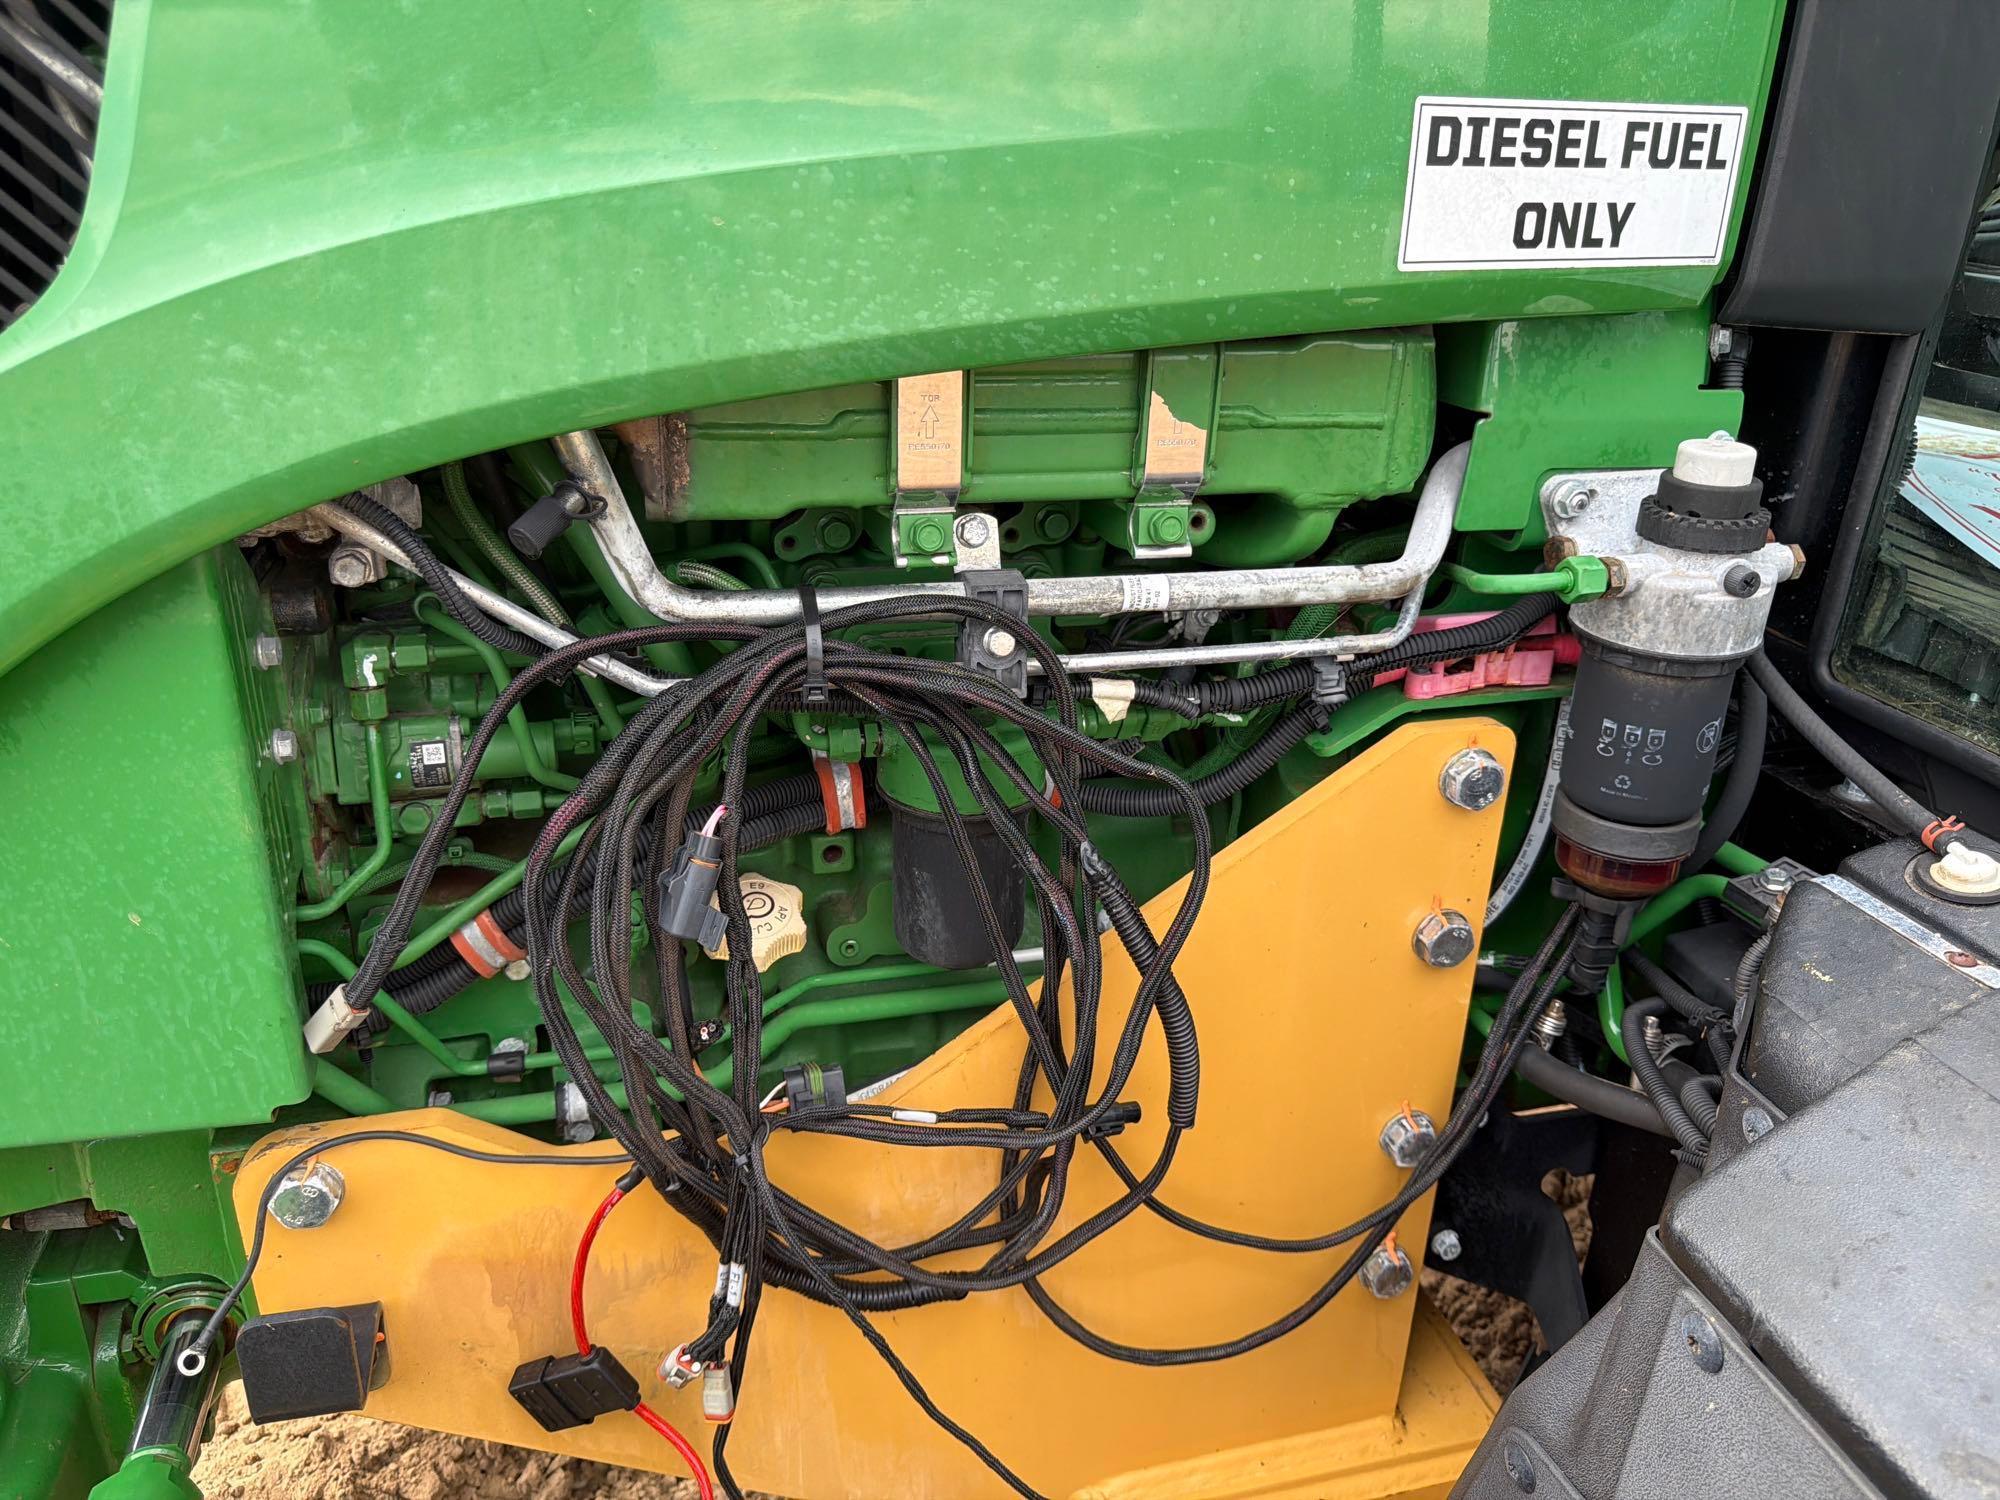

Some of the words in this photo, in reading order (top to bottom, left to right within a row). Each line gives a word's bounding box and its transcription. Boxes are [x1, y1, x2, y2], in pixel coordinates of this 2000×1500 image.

[1426, 116, 1607, 168] DIESEL
[1620, 121, 1726, 170] FUEL
[1513, 202, 1636, 249] ONLY
[750, 882, 765, 890] E9
[775, 905, 788, 923] API
